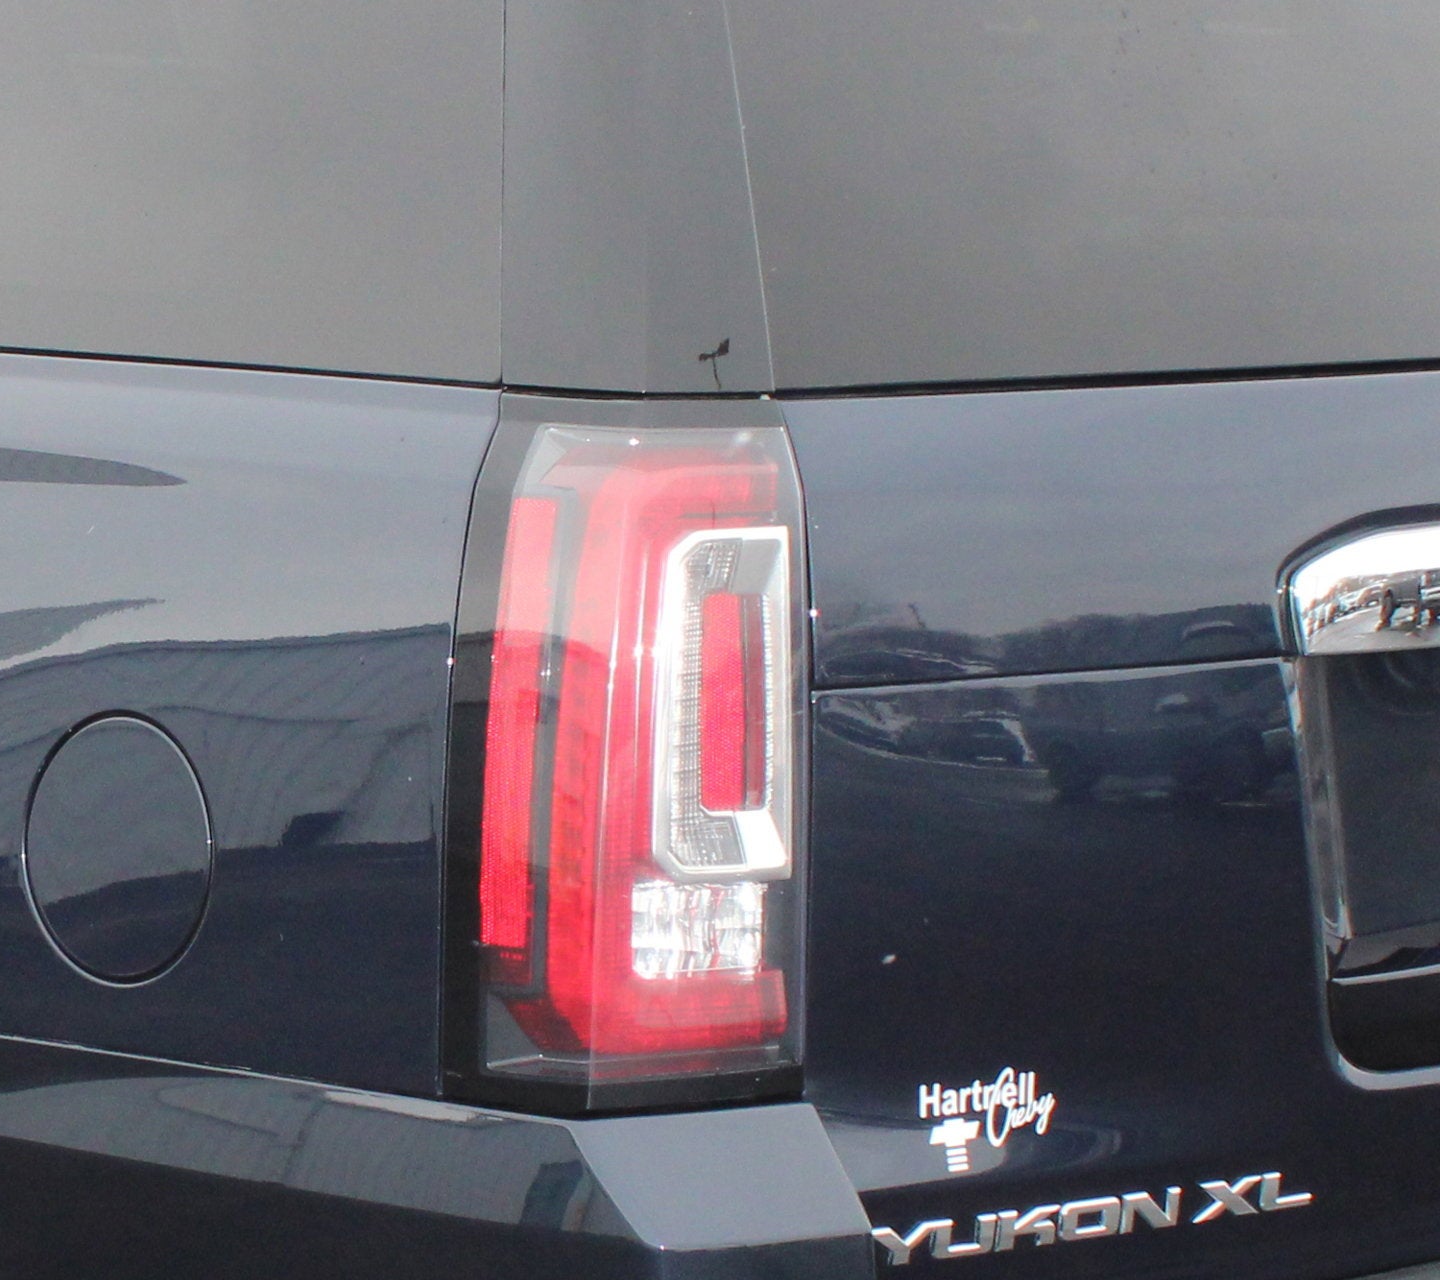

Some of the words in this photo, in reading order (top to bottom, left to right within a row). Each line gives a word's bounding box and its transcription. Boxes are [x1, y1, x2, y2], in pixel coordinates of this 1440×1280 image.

[919, 1071, 1036, 1118] Hartnell
[986, 1067, 1056, 1147] Chevy
[872, 1185, 1182, 1266] YUKON
[1193, 1171, 1315, 1223] XL
